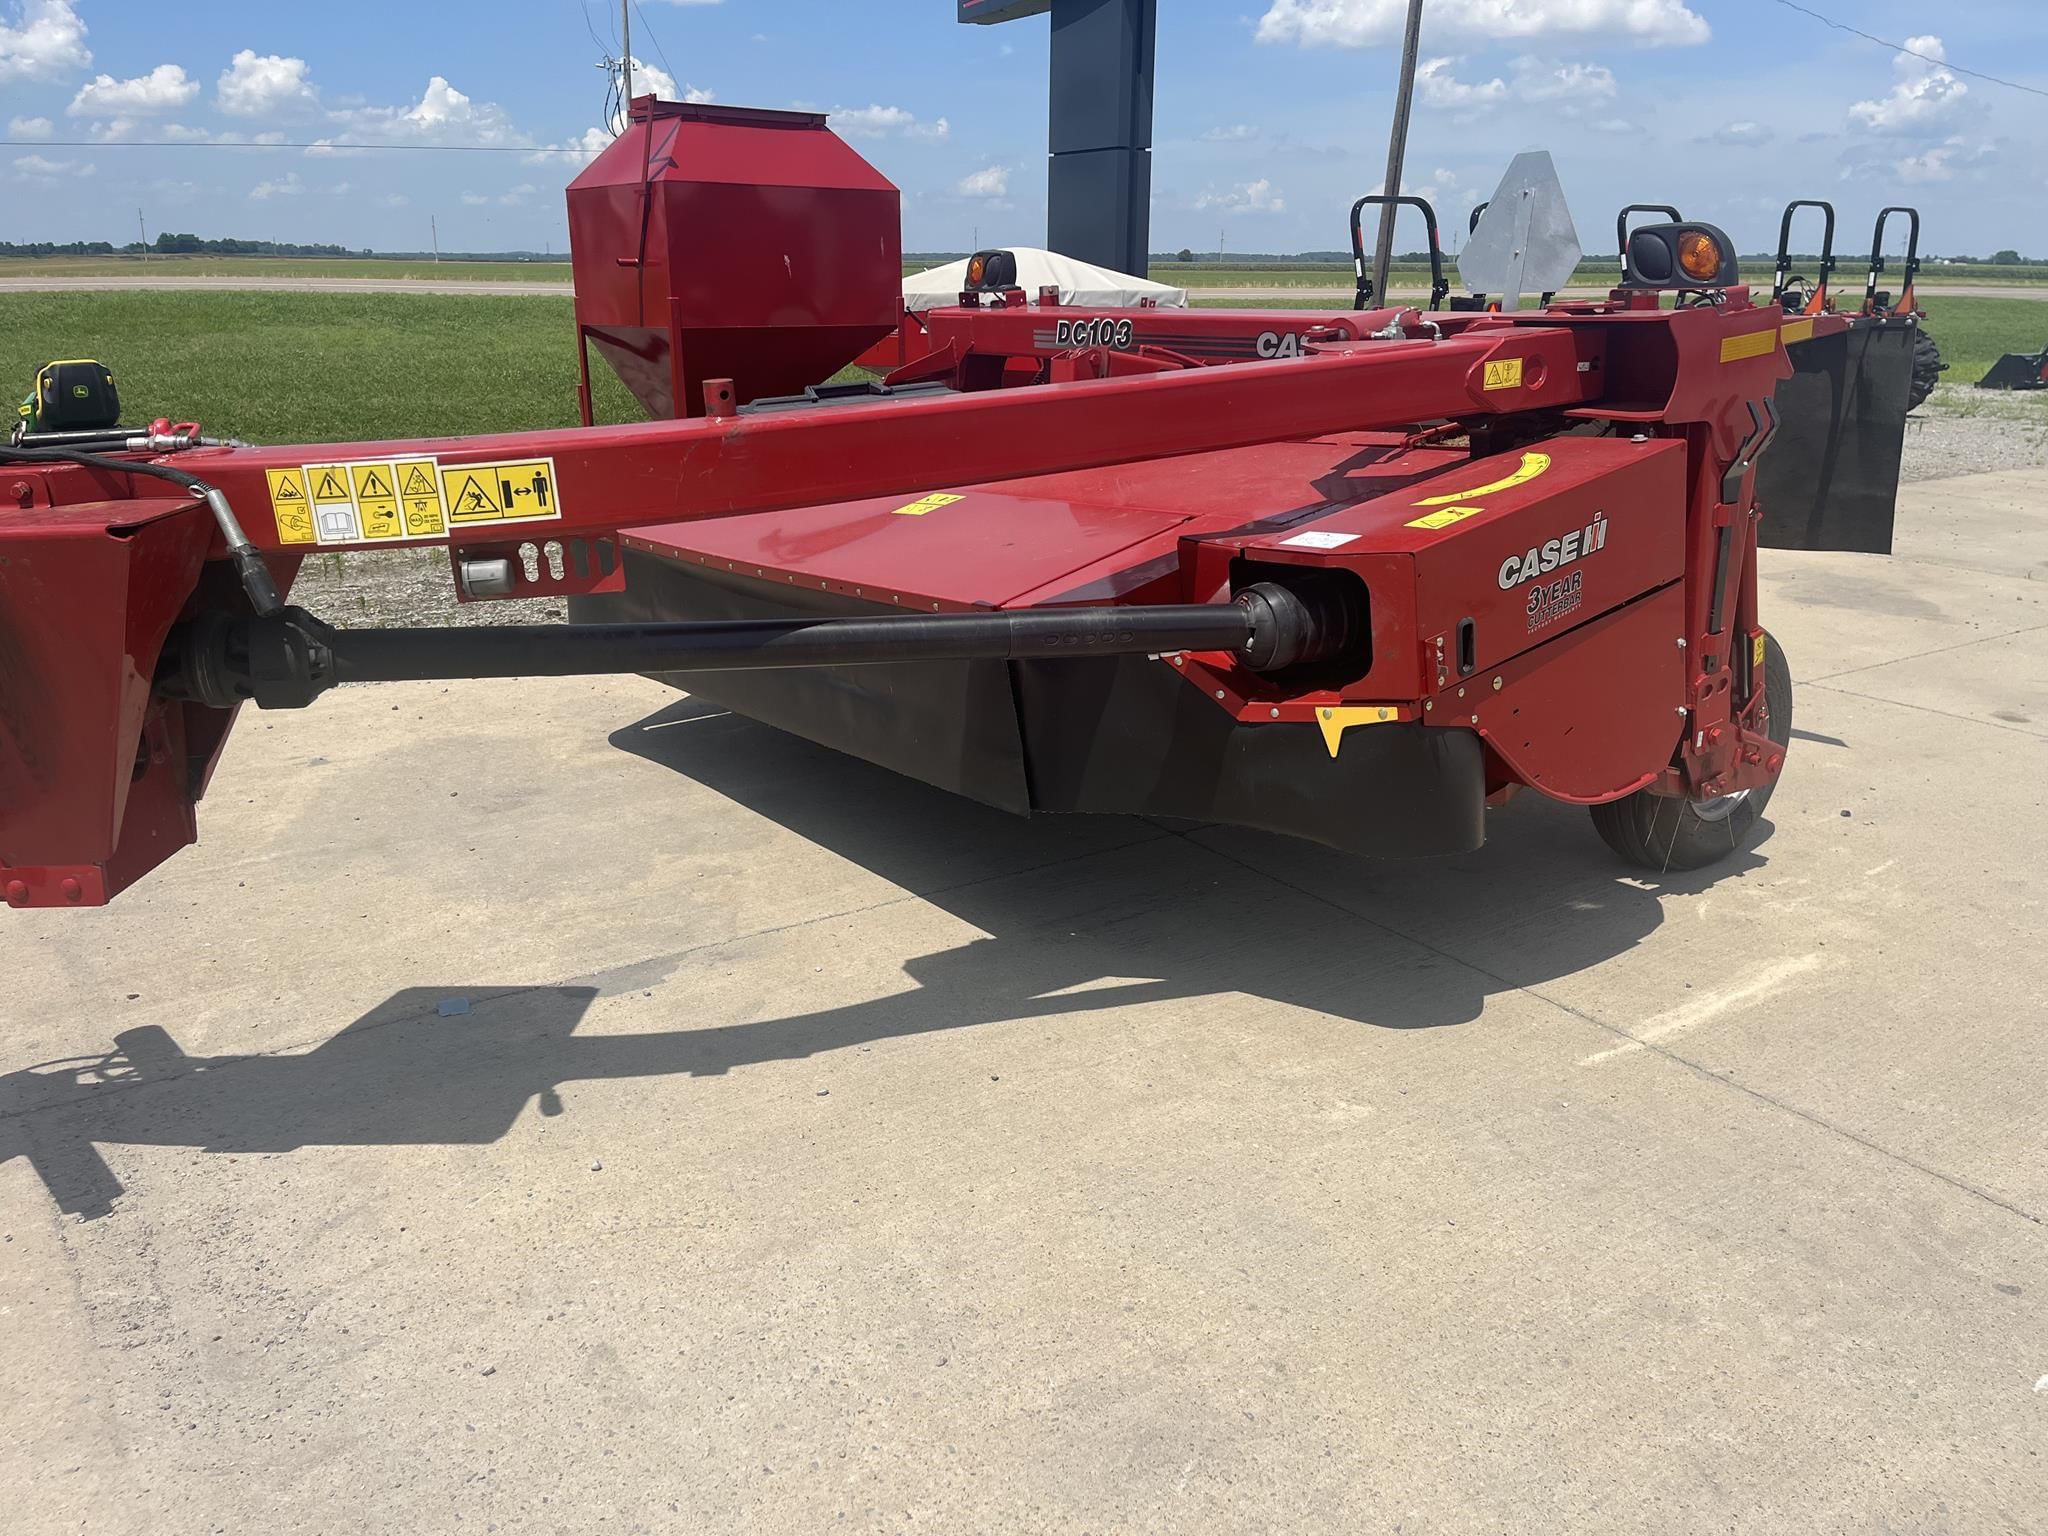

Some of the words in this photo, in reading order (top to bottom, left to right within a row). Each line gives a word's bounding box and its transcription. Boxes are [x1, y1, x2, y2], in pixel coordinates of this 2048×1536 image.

[1056, 318, 1133, 349] DC103
[1498, 530, 1581, 590] CASE
[1527, 590, 1582, 629] CUTTERBAR
